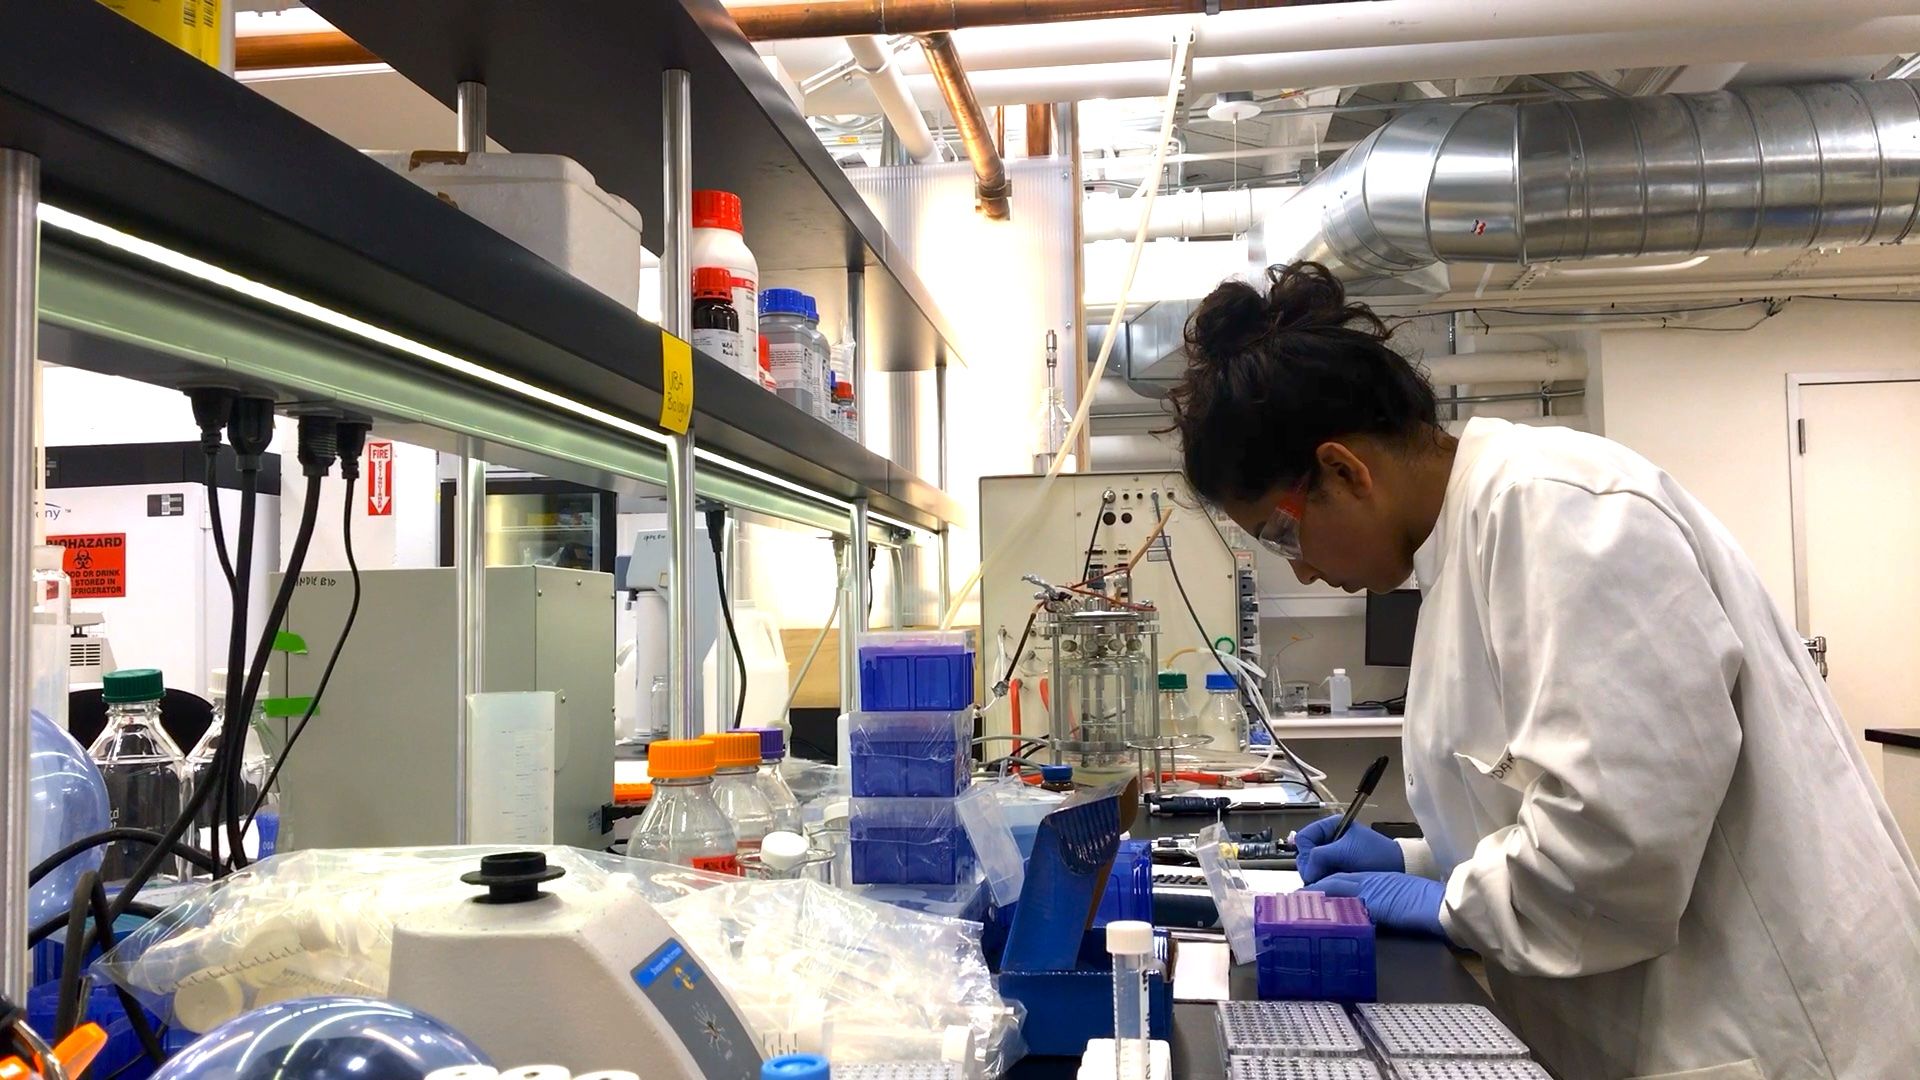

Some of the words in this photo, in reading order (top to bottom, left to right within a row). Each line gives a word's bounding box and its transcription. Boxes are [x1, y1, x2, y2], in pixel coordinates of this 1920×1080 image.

[372, 449, 389, 459] FIRE
[83, 570, 94, 578] OR
[96, 569, 120, 577] DRINK
[75, 578, 105, 586] STORED
[71, 586, 122, 595] EFRIGERATOR
